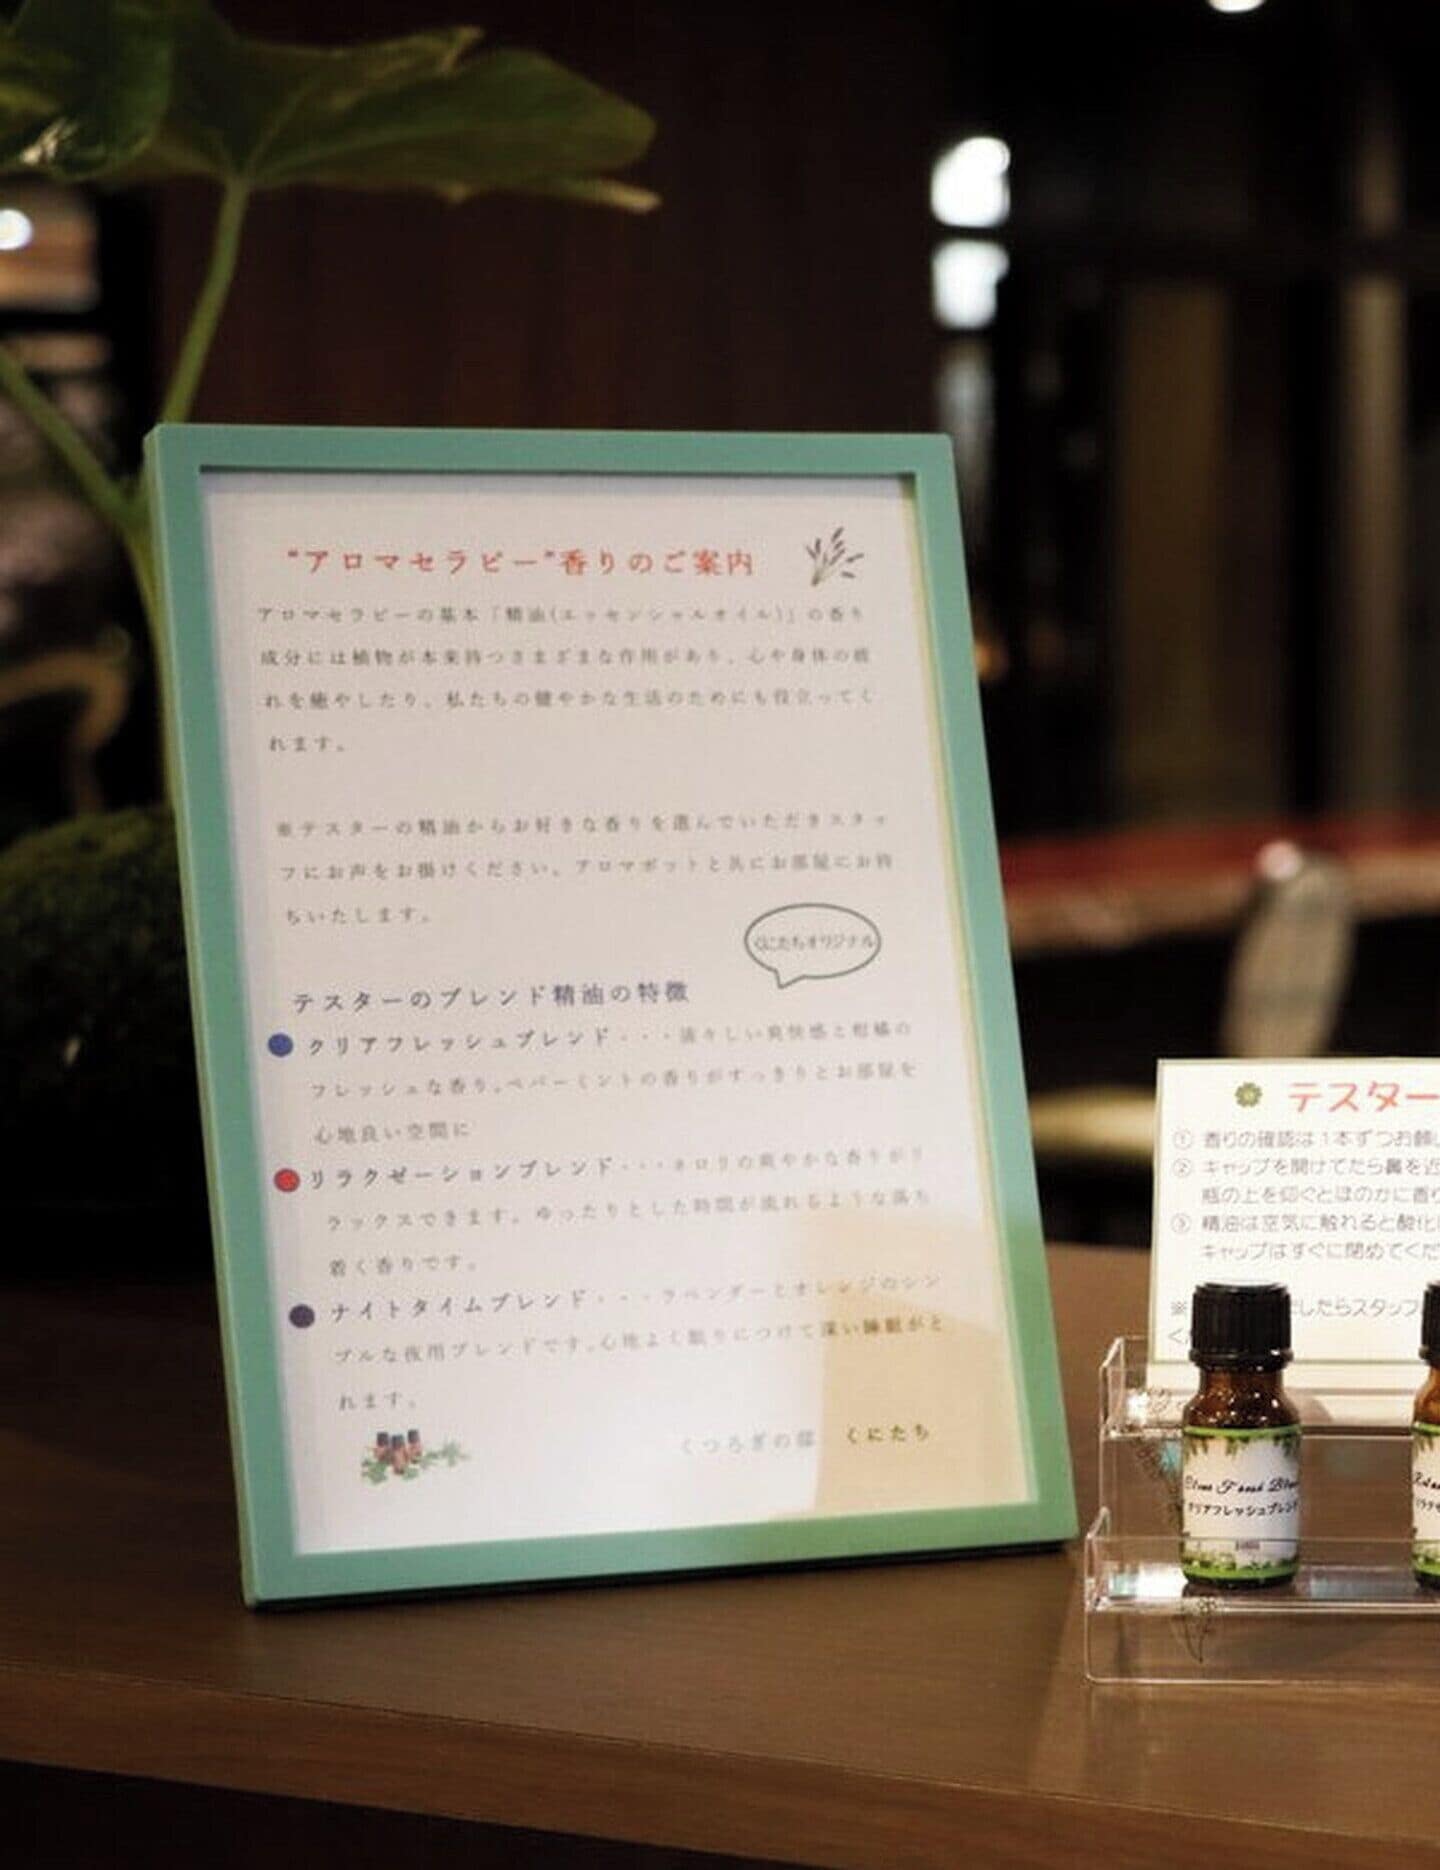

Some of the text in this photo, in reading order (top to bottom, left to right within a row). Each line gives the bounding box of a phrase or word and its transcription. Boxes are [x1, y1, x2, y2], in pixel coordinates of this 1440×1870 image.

[269, 735, 346, 753] れます。
[285, 907, 431, 926] ちいたします。
[294, 979, 690, 1014] テスターのブレンド精油の特徴
[1288, 1080, 1440, 1112] テスター
[313, 1121, 471, 1144] 心地良い空間に
[848, 1424, 928, 1444] くにたち
